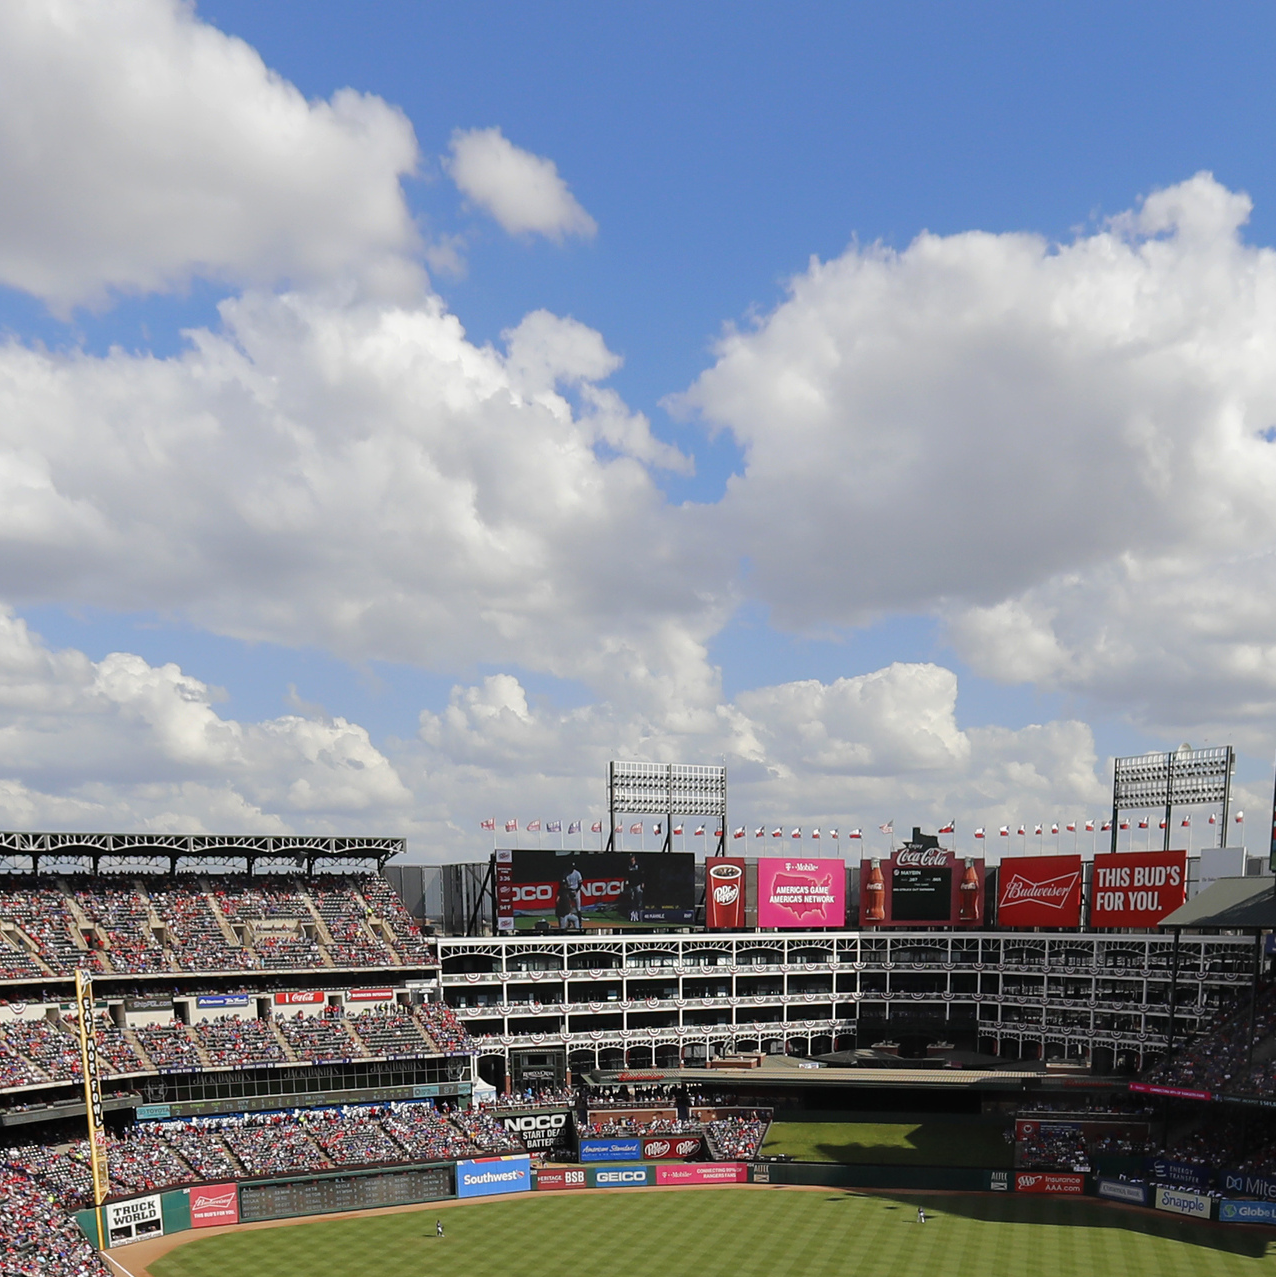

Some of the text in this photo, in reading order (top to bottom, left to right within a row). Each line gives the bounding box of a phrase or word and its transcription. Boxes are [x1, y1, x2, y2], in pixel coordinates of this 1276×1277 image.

[1097, 865, 1181, 888] THIS BUD'S
[776, 885, 829, 895] AMERICA'S GAME
[1006, 878, 1070, 899] Budweiser
[769, 894, 835, 903] AMERICA'S NETWORK
[1096, 891, 1163, 911] FOR YOU.
[83, 997, 102, 1127] EAT MOR FOWL
[504, 1114, 565, 1132] NOCO
[523, 1130, 545, 1140] START
[754, 1164, 769, 1173] ALTEC
[1169, 1165, 1193, 1175] ENERGY
[464, 1170, 518, 1185] Southwest
[565, 1171, 584, 1183] BSB
[596, 1171, 646, 1182] GEICO
[990, 1172, 1007, 1180] ALTEC
[1045, 1176, 1080, 1184] Insurance
[1169, 1173, 1199, 1184] TRANSFER
[1045, 1184, 1080, 1192] AAA.com
[1161, 1191, 1204, 1213] Snapple
[113, 1201, 156, 1216] TRUCK
[1239, 1207, 1269, 1218] Globe
[113, 1209, 157, 1225] WORLD
